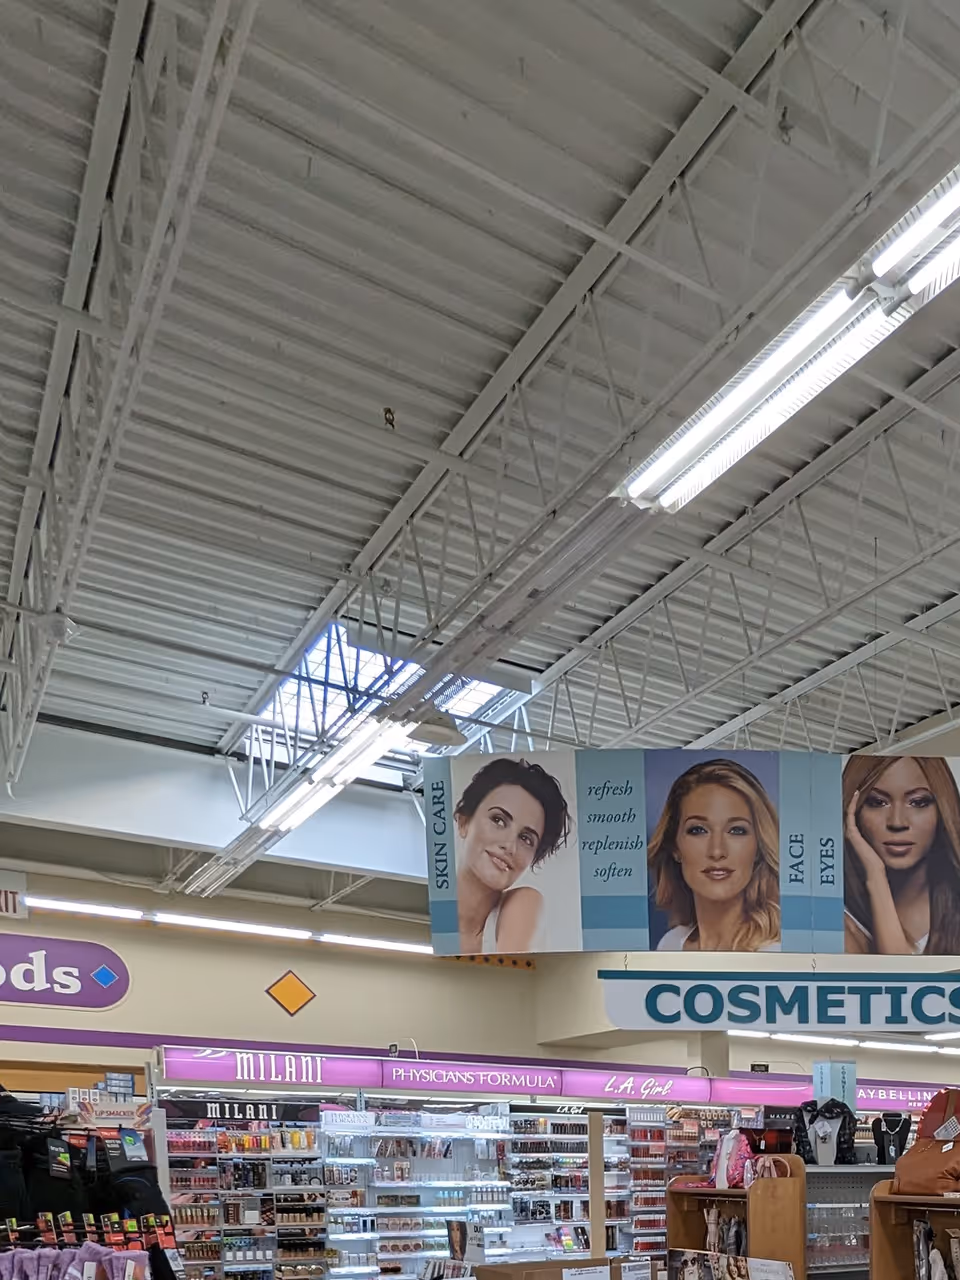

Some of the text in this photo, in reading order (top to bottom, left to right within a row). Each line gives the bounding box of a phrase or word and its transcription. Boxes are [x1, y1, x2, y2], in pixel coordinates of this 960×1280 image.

[587, 780, 633, 799] refresh
[586, 808, 636, 824] smooth
[432, 780, 449, 890] SKIN CARE
[581, 836, 644, 854] replenish
[788, 833, 804, 884] FACE
[820, 837, 835, 886] EYES
[593, 863, 633, 882] soften
[236, 1052, 323, 1083] MILANI
[392, 1068, 557, 1088] PHYSICIANS FORMULA
[604, 1076, 672, 1099] L.A. Girl
[858, 1089, 938, 1100] AYBELLIN
[206, 1103, 278, 1120] MILANI
